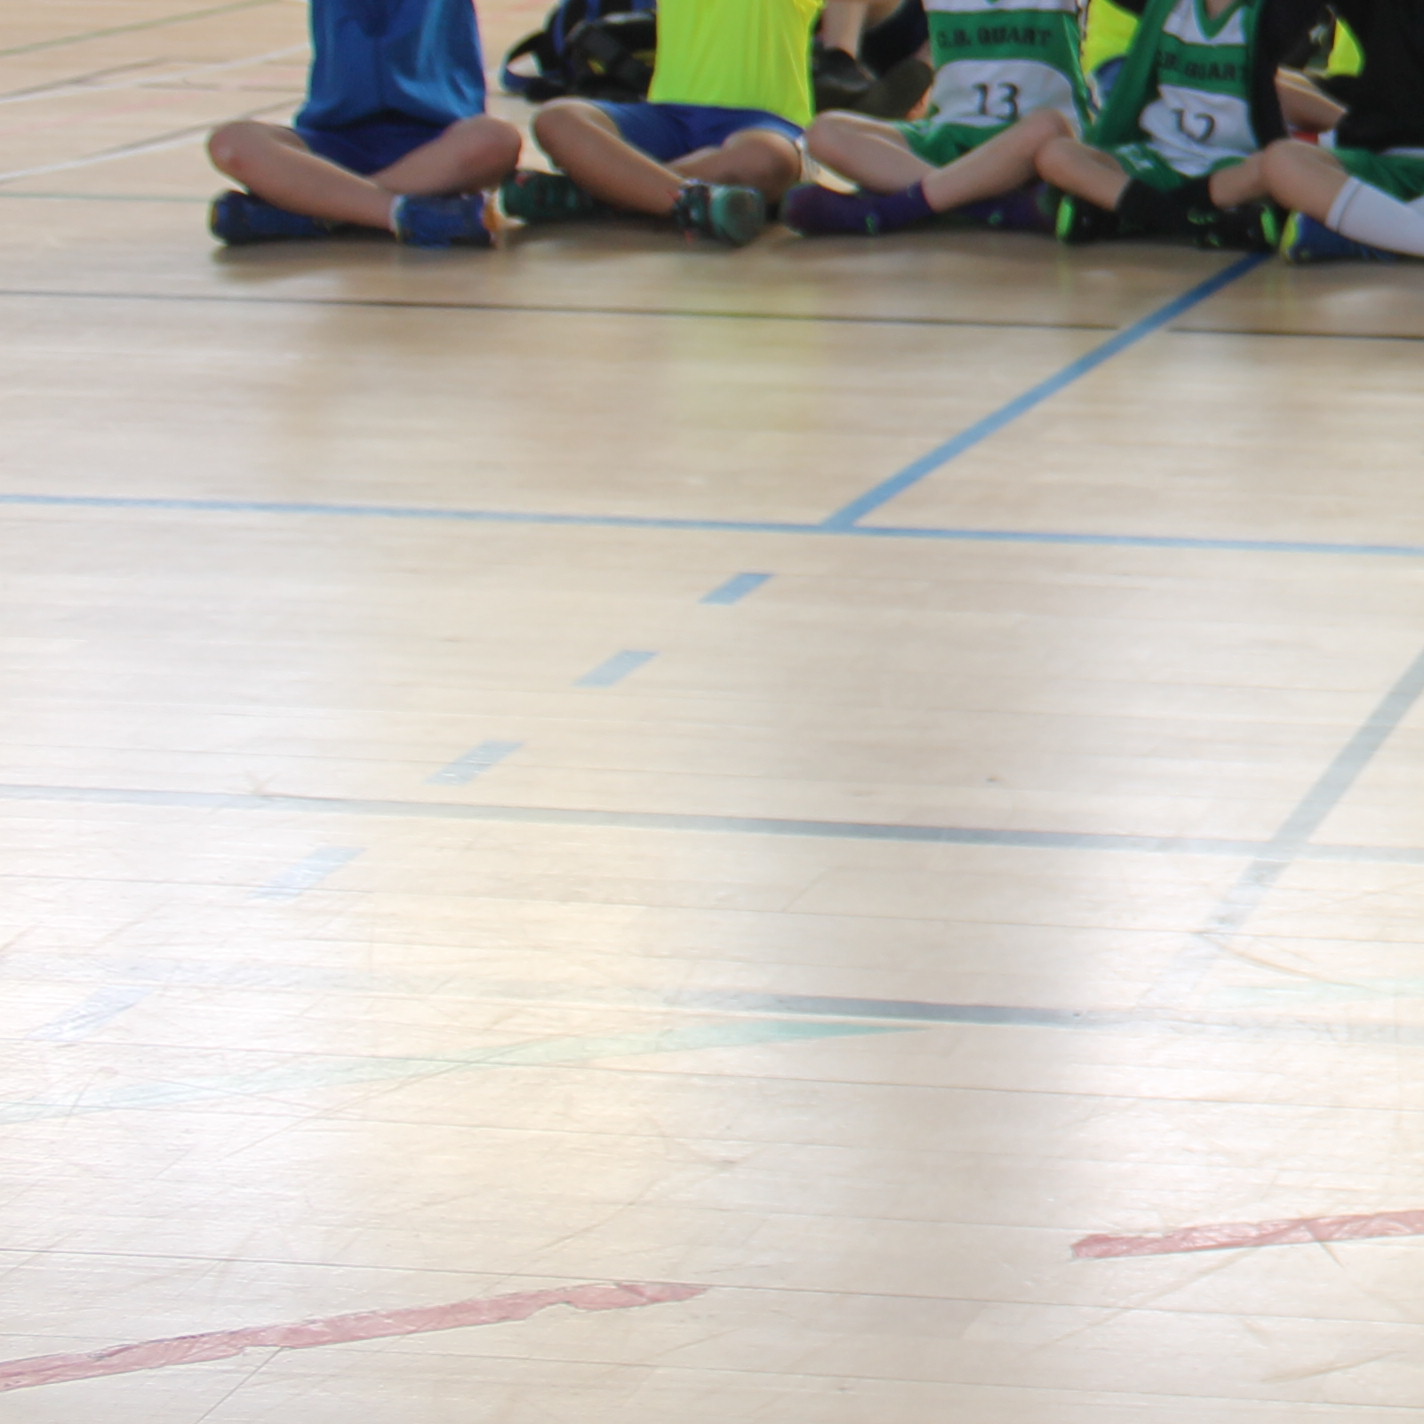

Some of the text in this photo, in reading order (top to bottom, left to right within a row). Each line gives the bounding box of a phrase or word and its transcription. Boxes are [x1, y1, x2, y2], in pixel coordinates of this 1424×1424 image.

[977, 26, 1052, 47] QUART
[1184, 54, 1248, 81] QUAR
[973, 82, 1019, 118] 13
